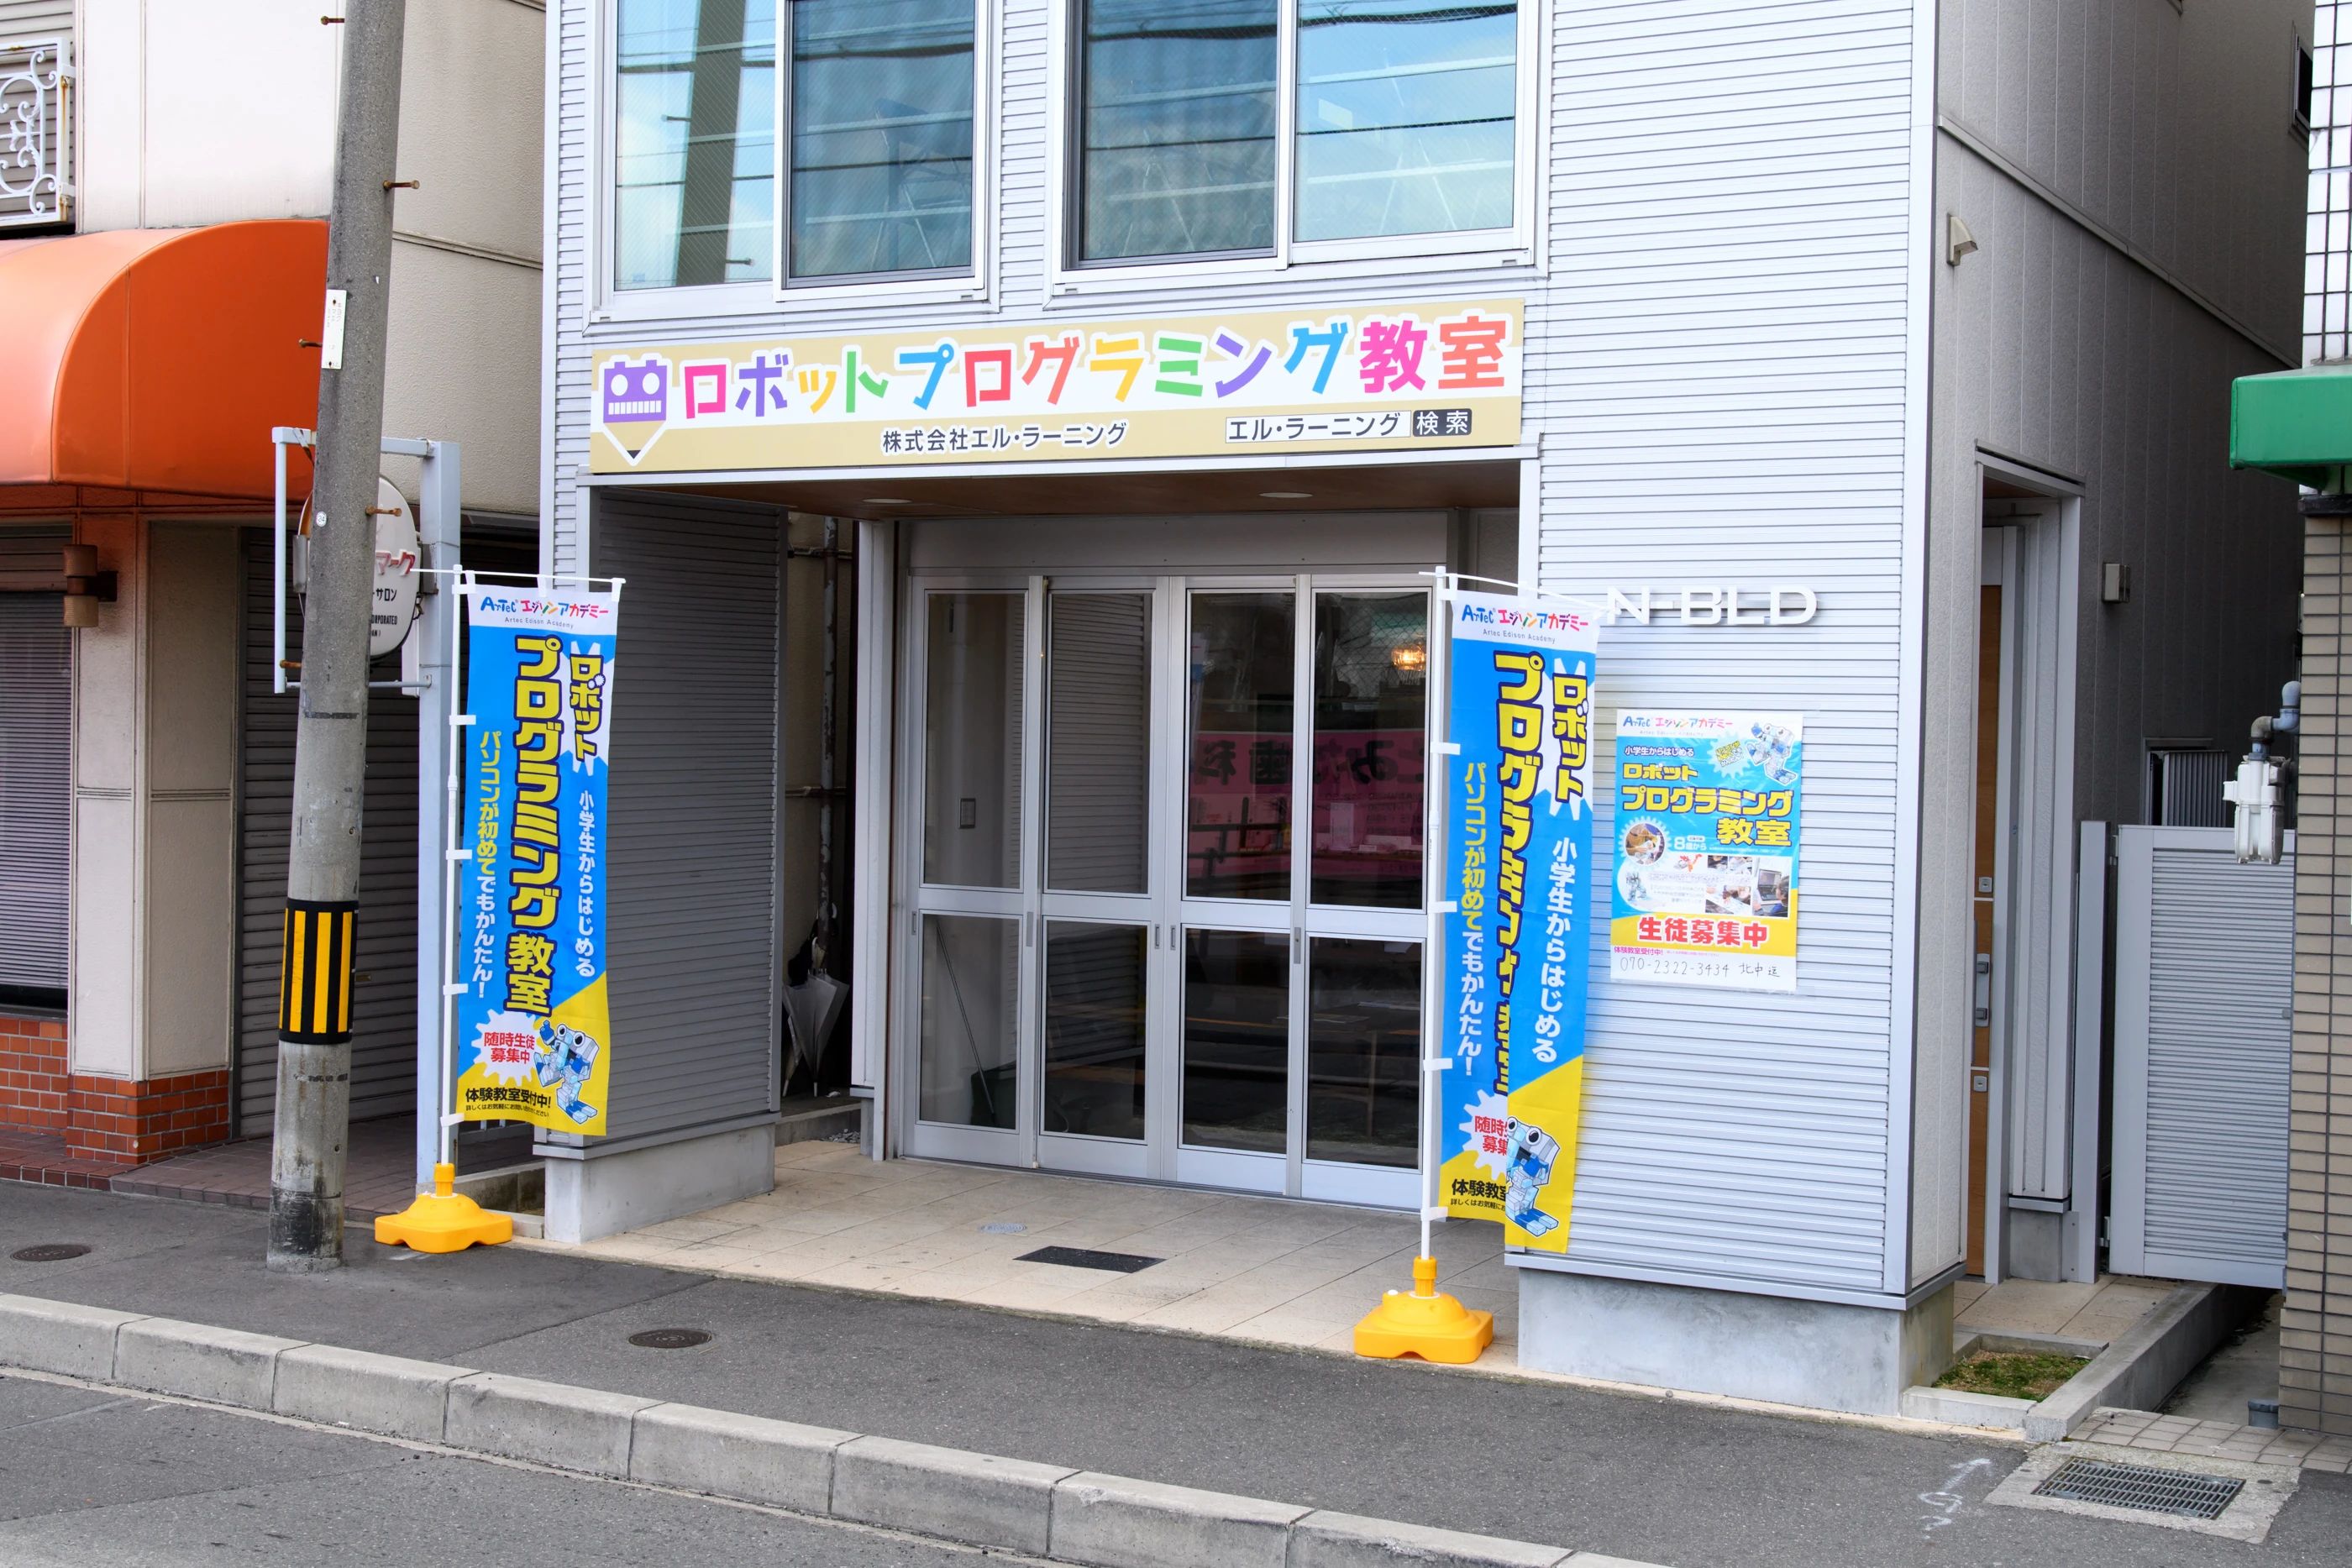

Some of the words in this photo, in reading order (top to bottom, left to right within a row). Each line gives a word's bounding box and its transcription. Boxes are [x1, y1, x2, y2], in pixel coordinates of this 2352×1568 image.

[685, 315, 1507, 419] ロボットプログラミング教室
[883, 422, 1126, 453] 株式会社エル・ラーニング
[1229, 412, 1401, 441] エル・ラーニング
[1416, 410, 1472, 435] 検索
[372, 588, 397, 601] サロン
[1607, 587, 1818, 625] N-BLD
[1483, 628, 1500, 637] Artec
[1503, 630, 1525, 639] Edison
[1528, 633, 1556, 644] Academy
[570, 653, 606, 762] ロボット
[1552, 673, 1589, 803] ロボット
[1625, 746, 1694, 757] 小学生からはじめる
[1623, 763, 1698, 781] ロボット
[1621, 784, 1793, 818] プログラミング
[1716, 816, 1792, 847] 教室
[575, 790, 596, 978] 小学生からはじめる
[1639, 916, 1767, 947] 生徒募集中
[1532, 837, 1578, 1063] 小学生からはじめる
[484, 1032, 535, 1050] 随時生徒
[491, 1047, 530, 1064] 募集中
[1475, 1115, 1508, 1136] 随時
